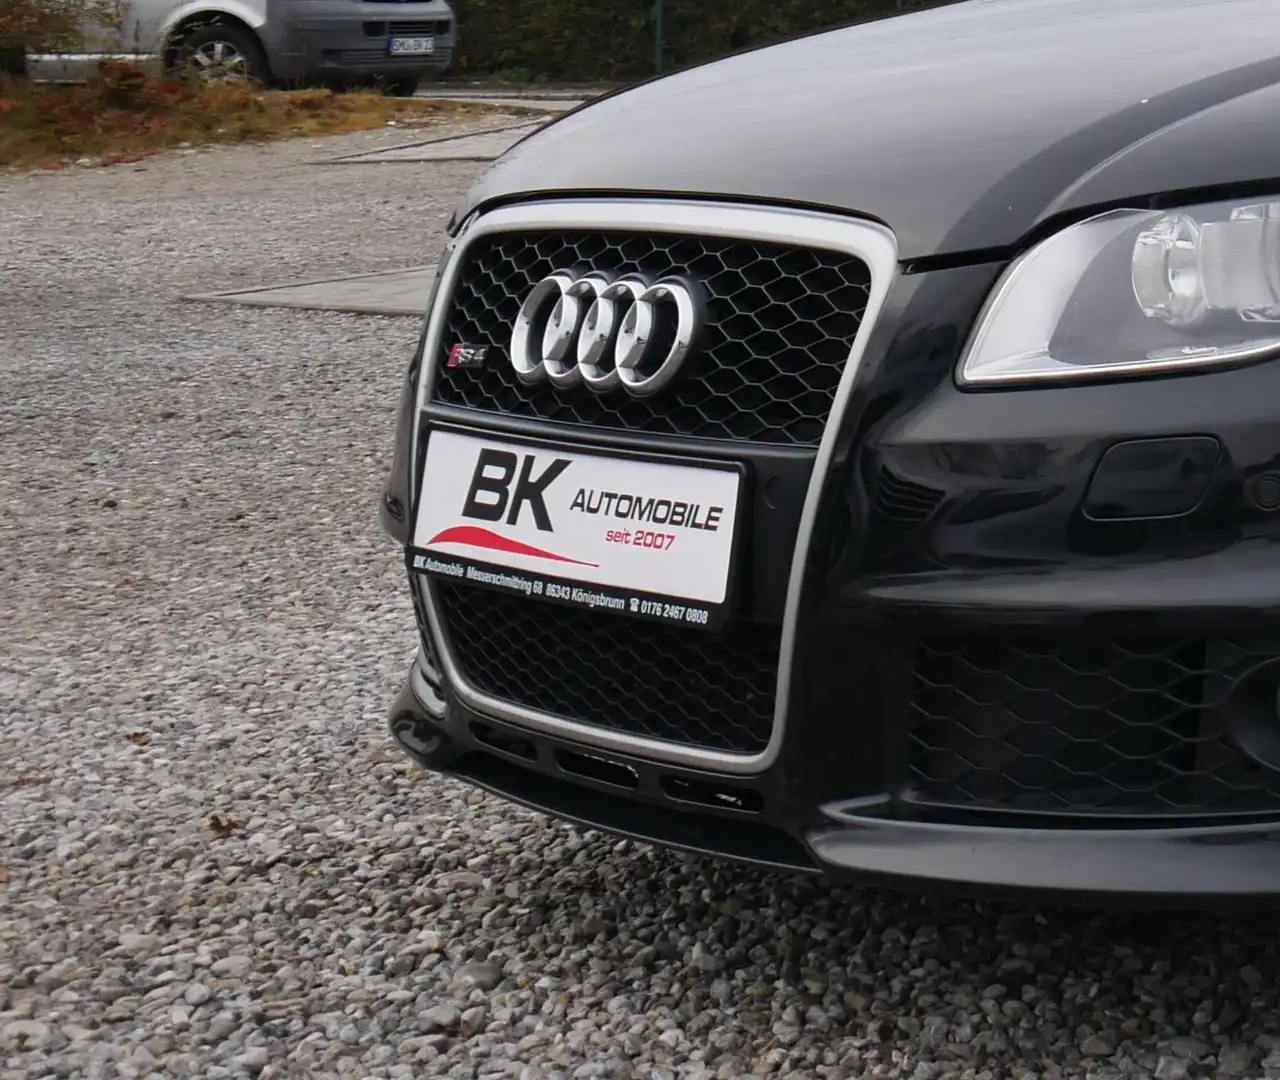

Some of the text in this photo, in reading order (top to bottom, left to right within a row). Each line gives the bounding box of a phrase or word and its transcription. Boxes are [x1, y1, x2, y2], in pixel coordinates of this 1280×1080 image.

[461, 448, 724, 533] BK AUTOMOBILE
[605, 527, 676, 550] seit 2007
[413, 554, 709, 624] BK Automobile Messerschmittring 68 86343 Königsbrunn 0176 2467 0808
